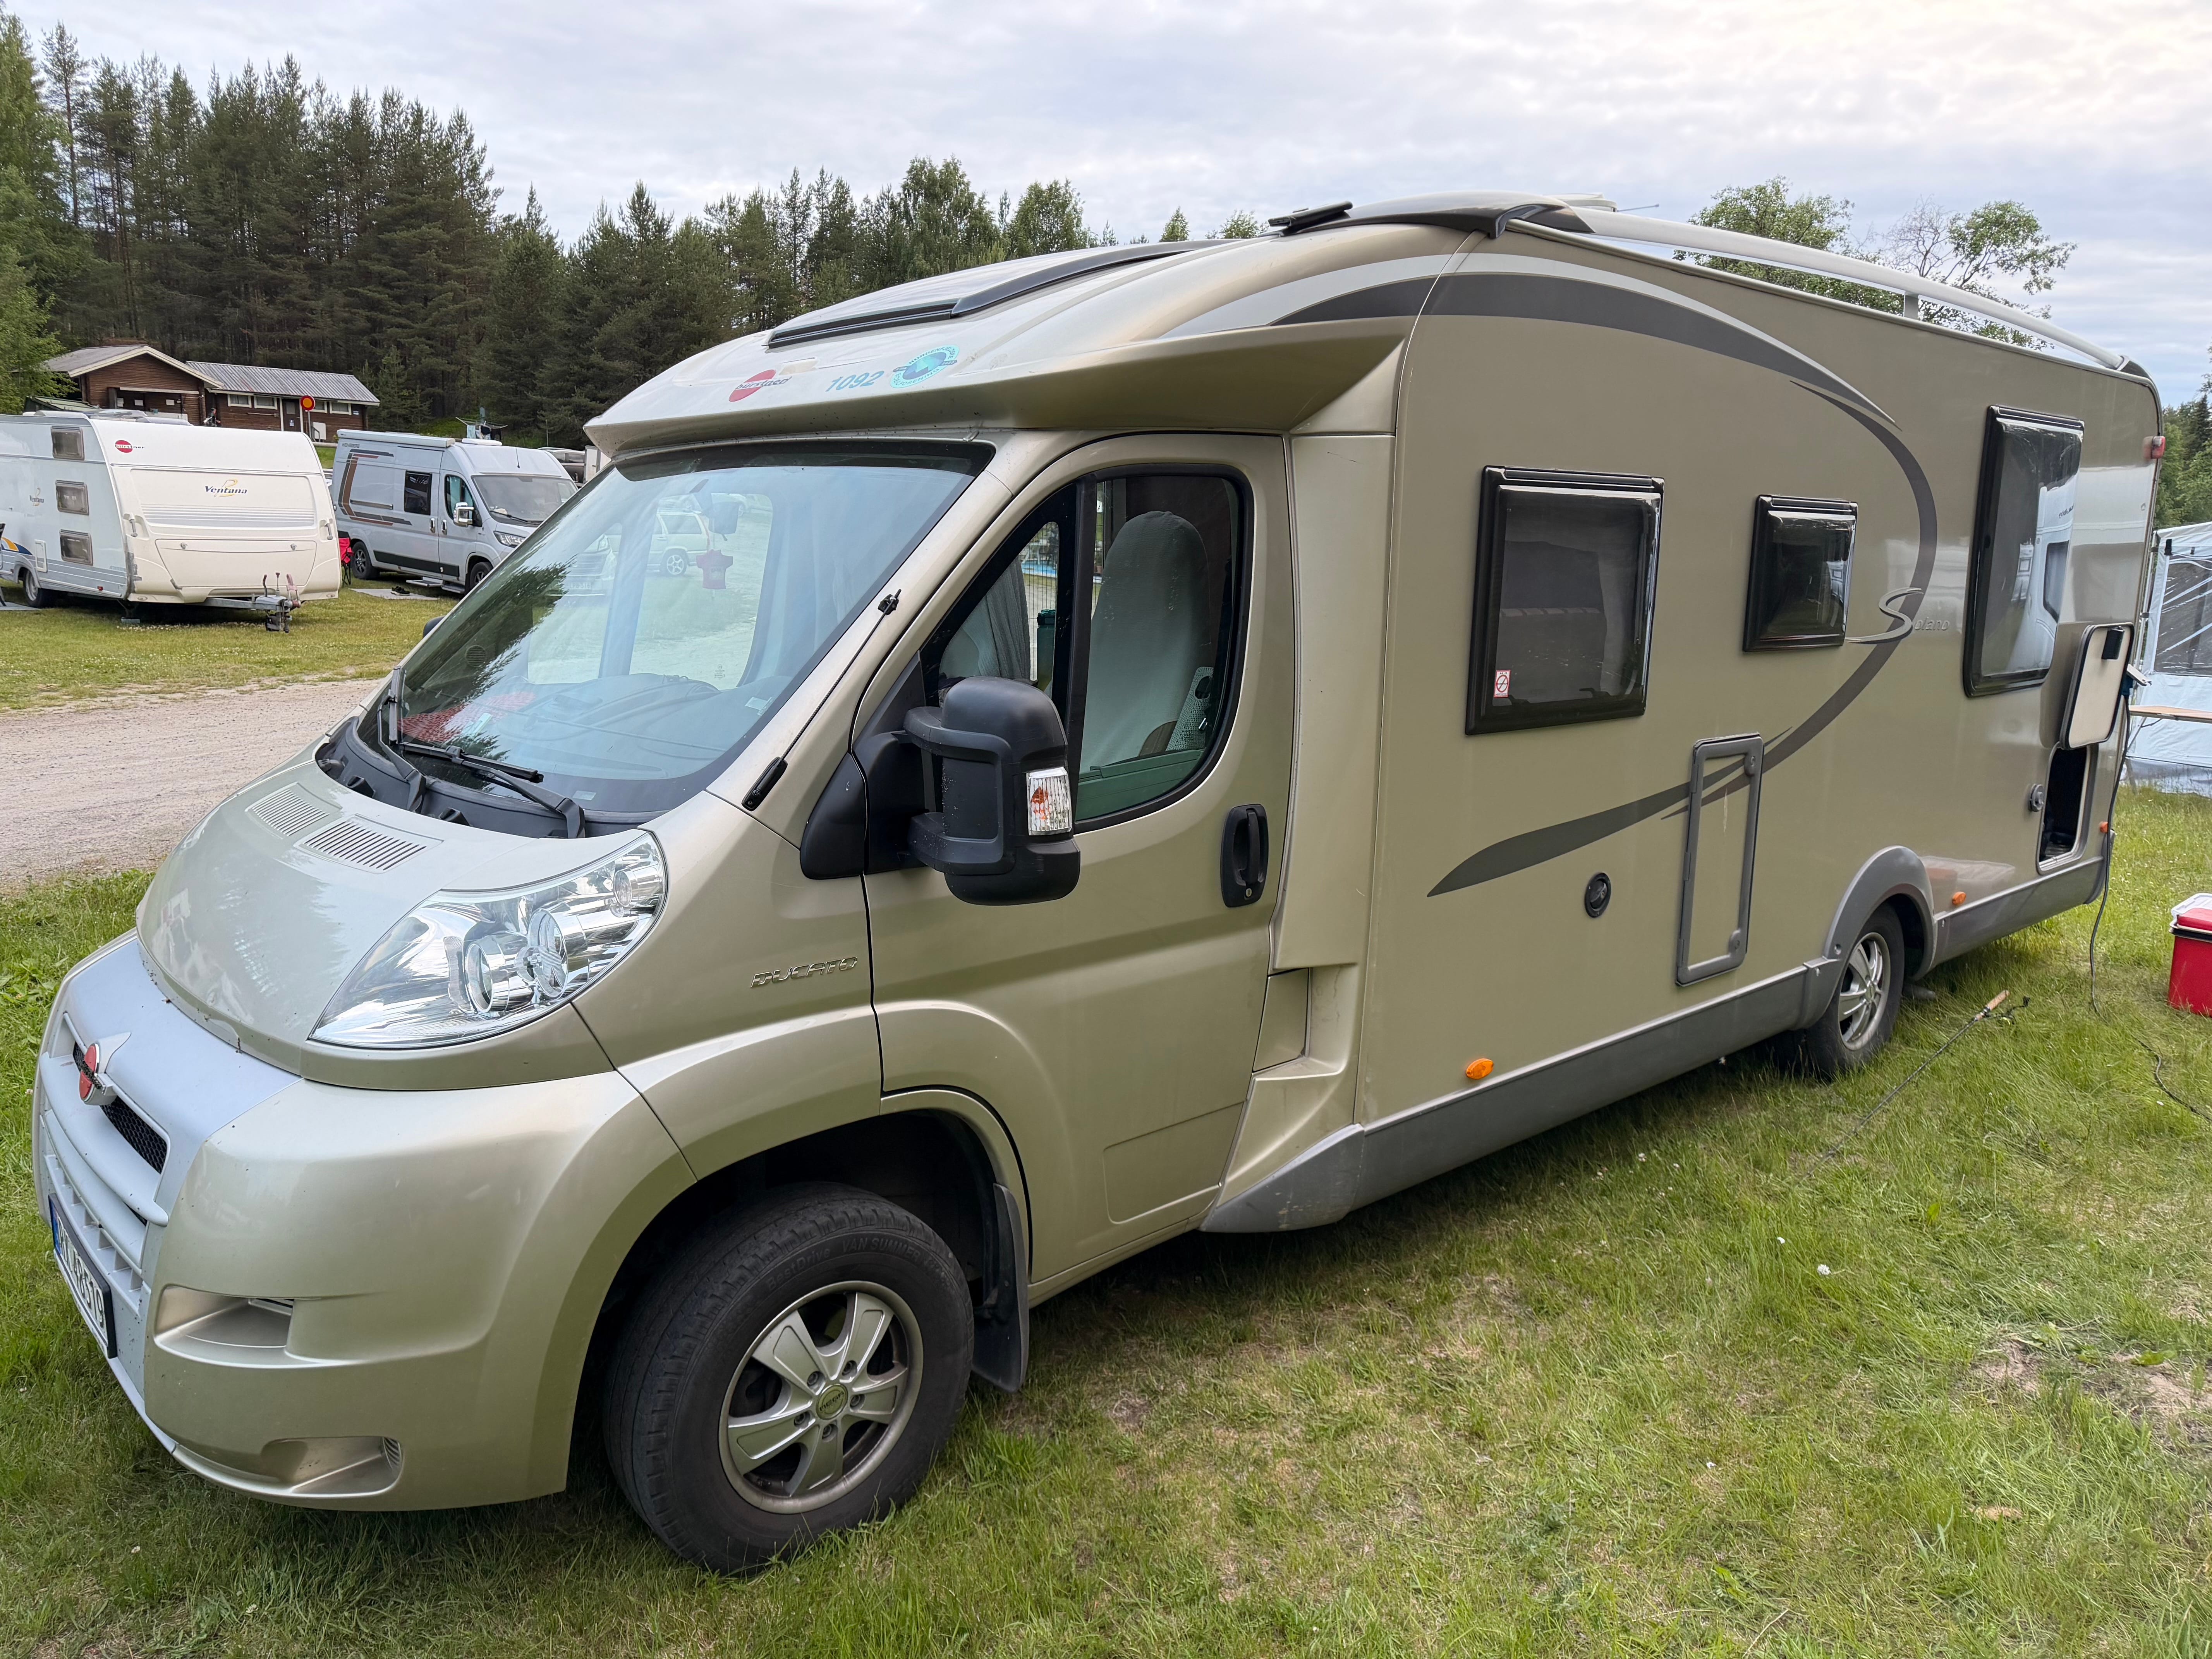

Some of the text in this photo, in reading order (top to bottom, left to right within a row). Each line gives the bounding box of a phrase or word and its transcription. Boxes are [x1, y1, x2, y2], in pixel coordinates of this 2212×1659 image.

[825, 371, 884, 392] 1092
[1844, 587, 1950, 644] Solano
[750, 957, 858, 988] DUCATO
[767, 1237, 921, 1290] BestDrive VAN SUMMER
